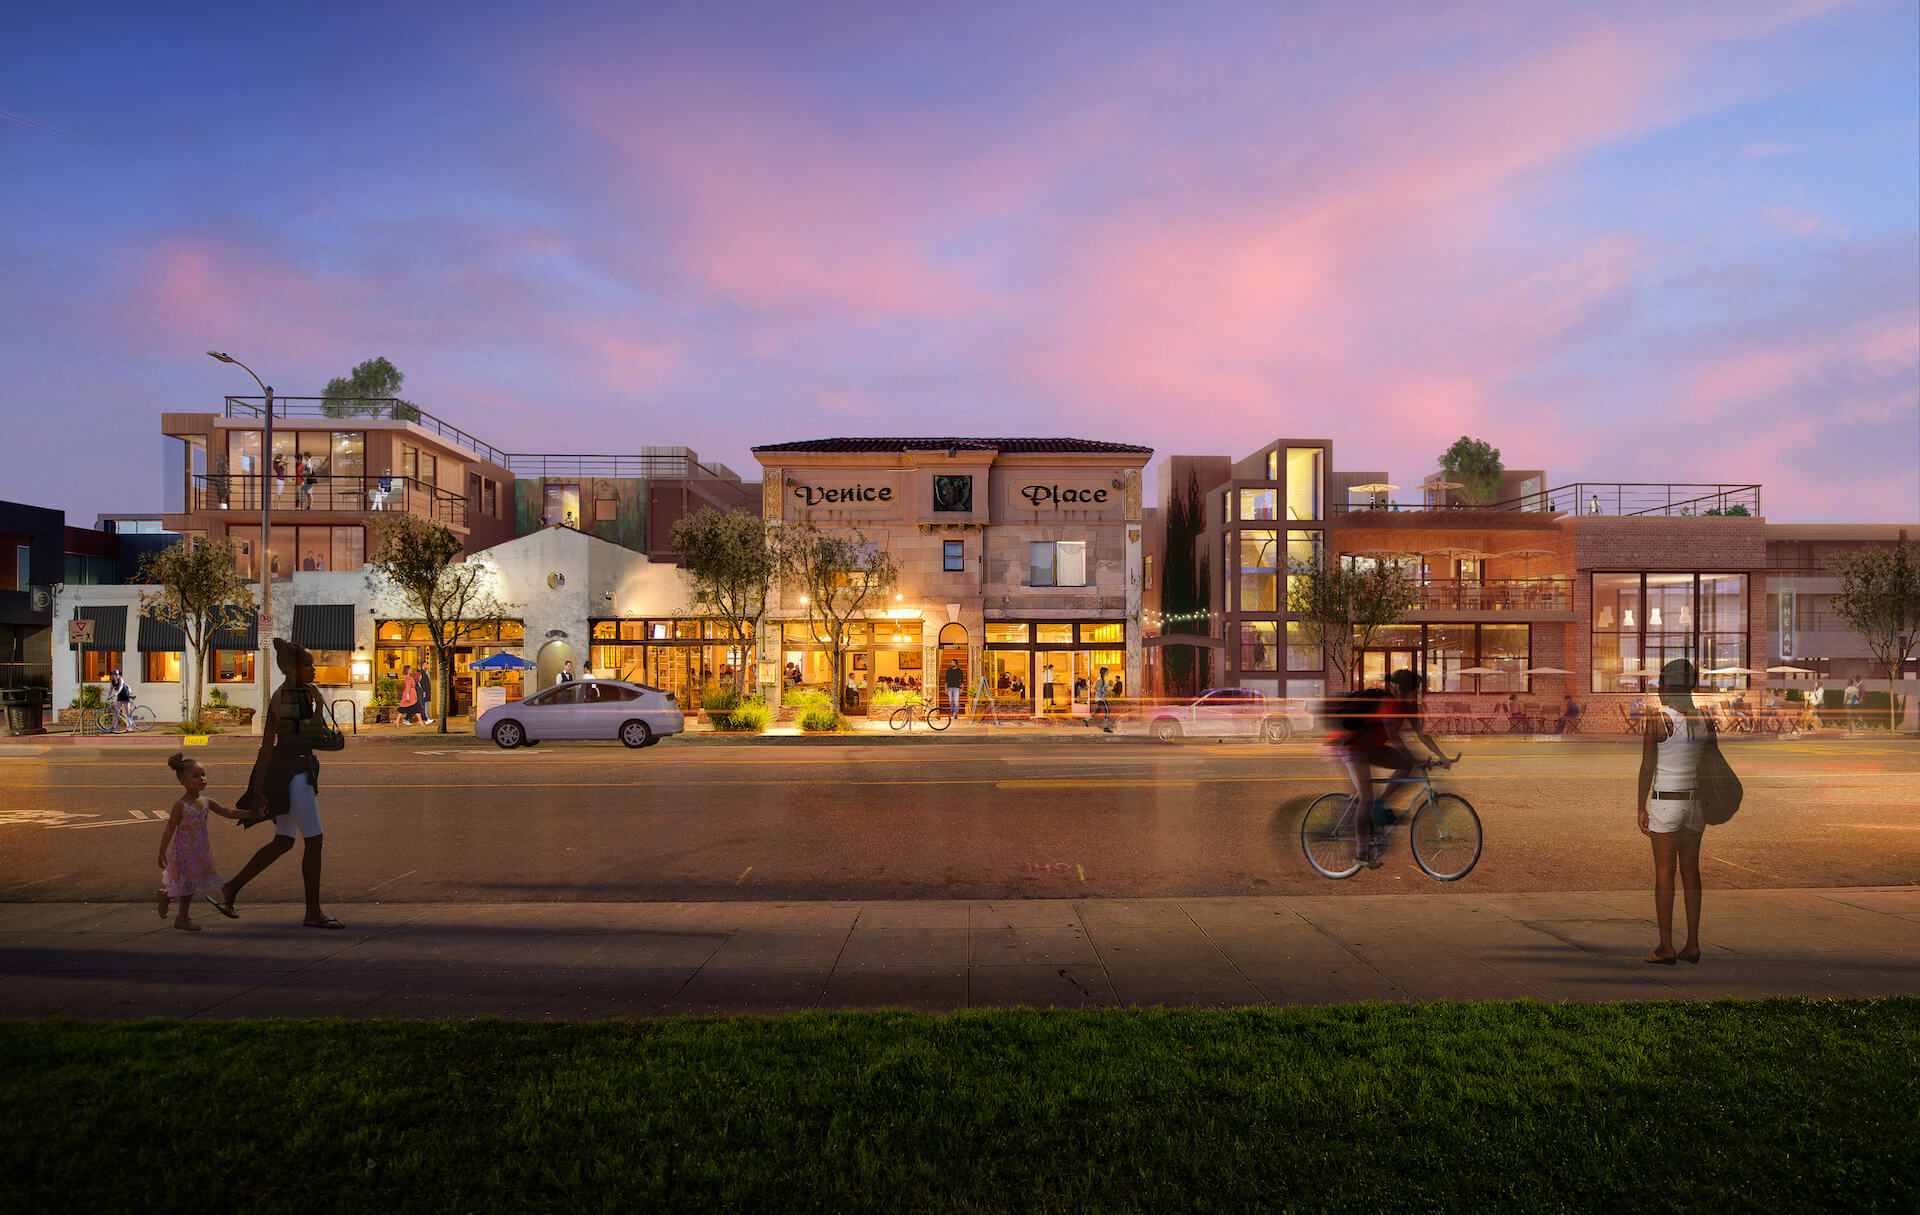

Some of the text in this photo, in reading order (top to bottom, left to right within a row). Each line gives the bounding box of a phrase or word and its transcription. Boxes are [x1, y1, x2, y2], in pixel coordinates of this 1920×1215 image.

[794, 484, 1107, 506] Venice Place
[1783, 595, 1791, 626] THE
